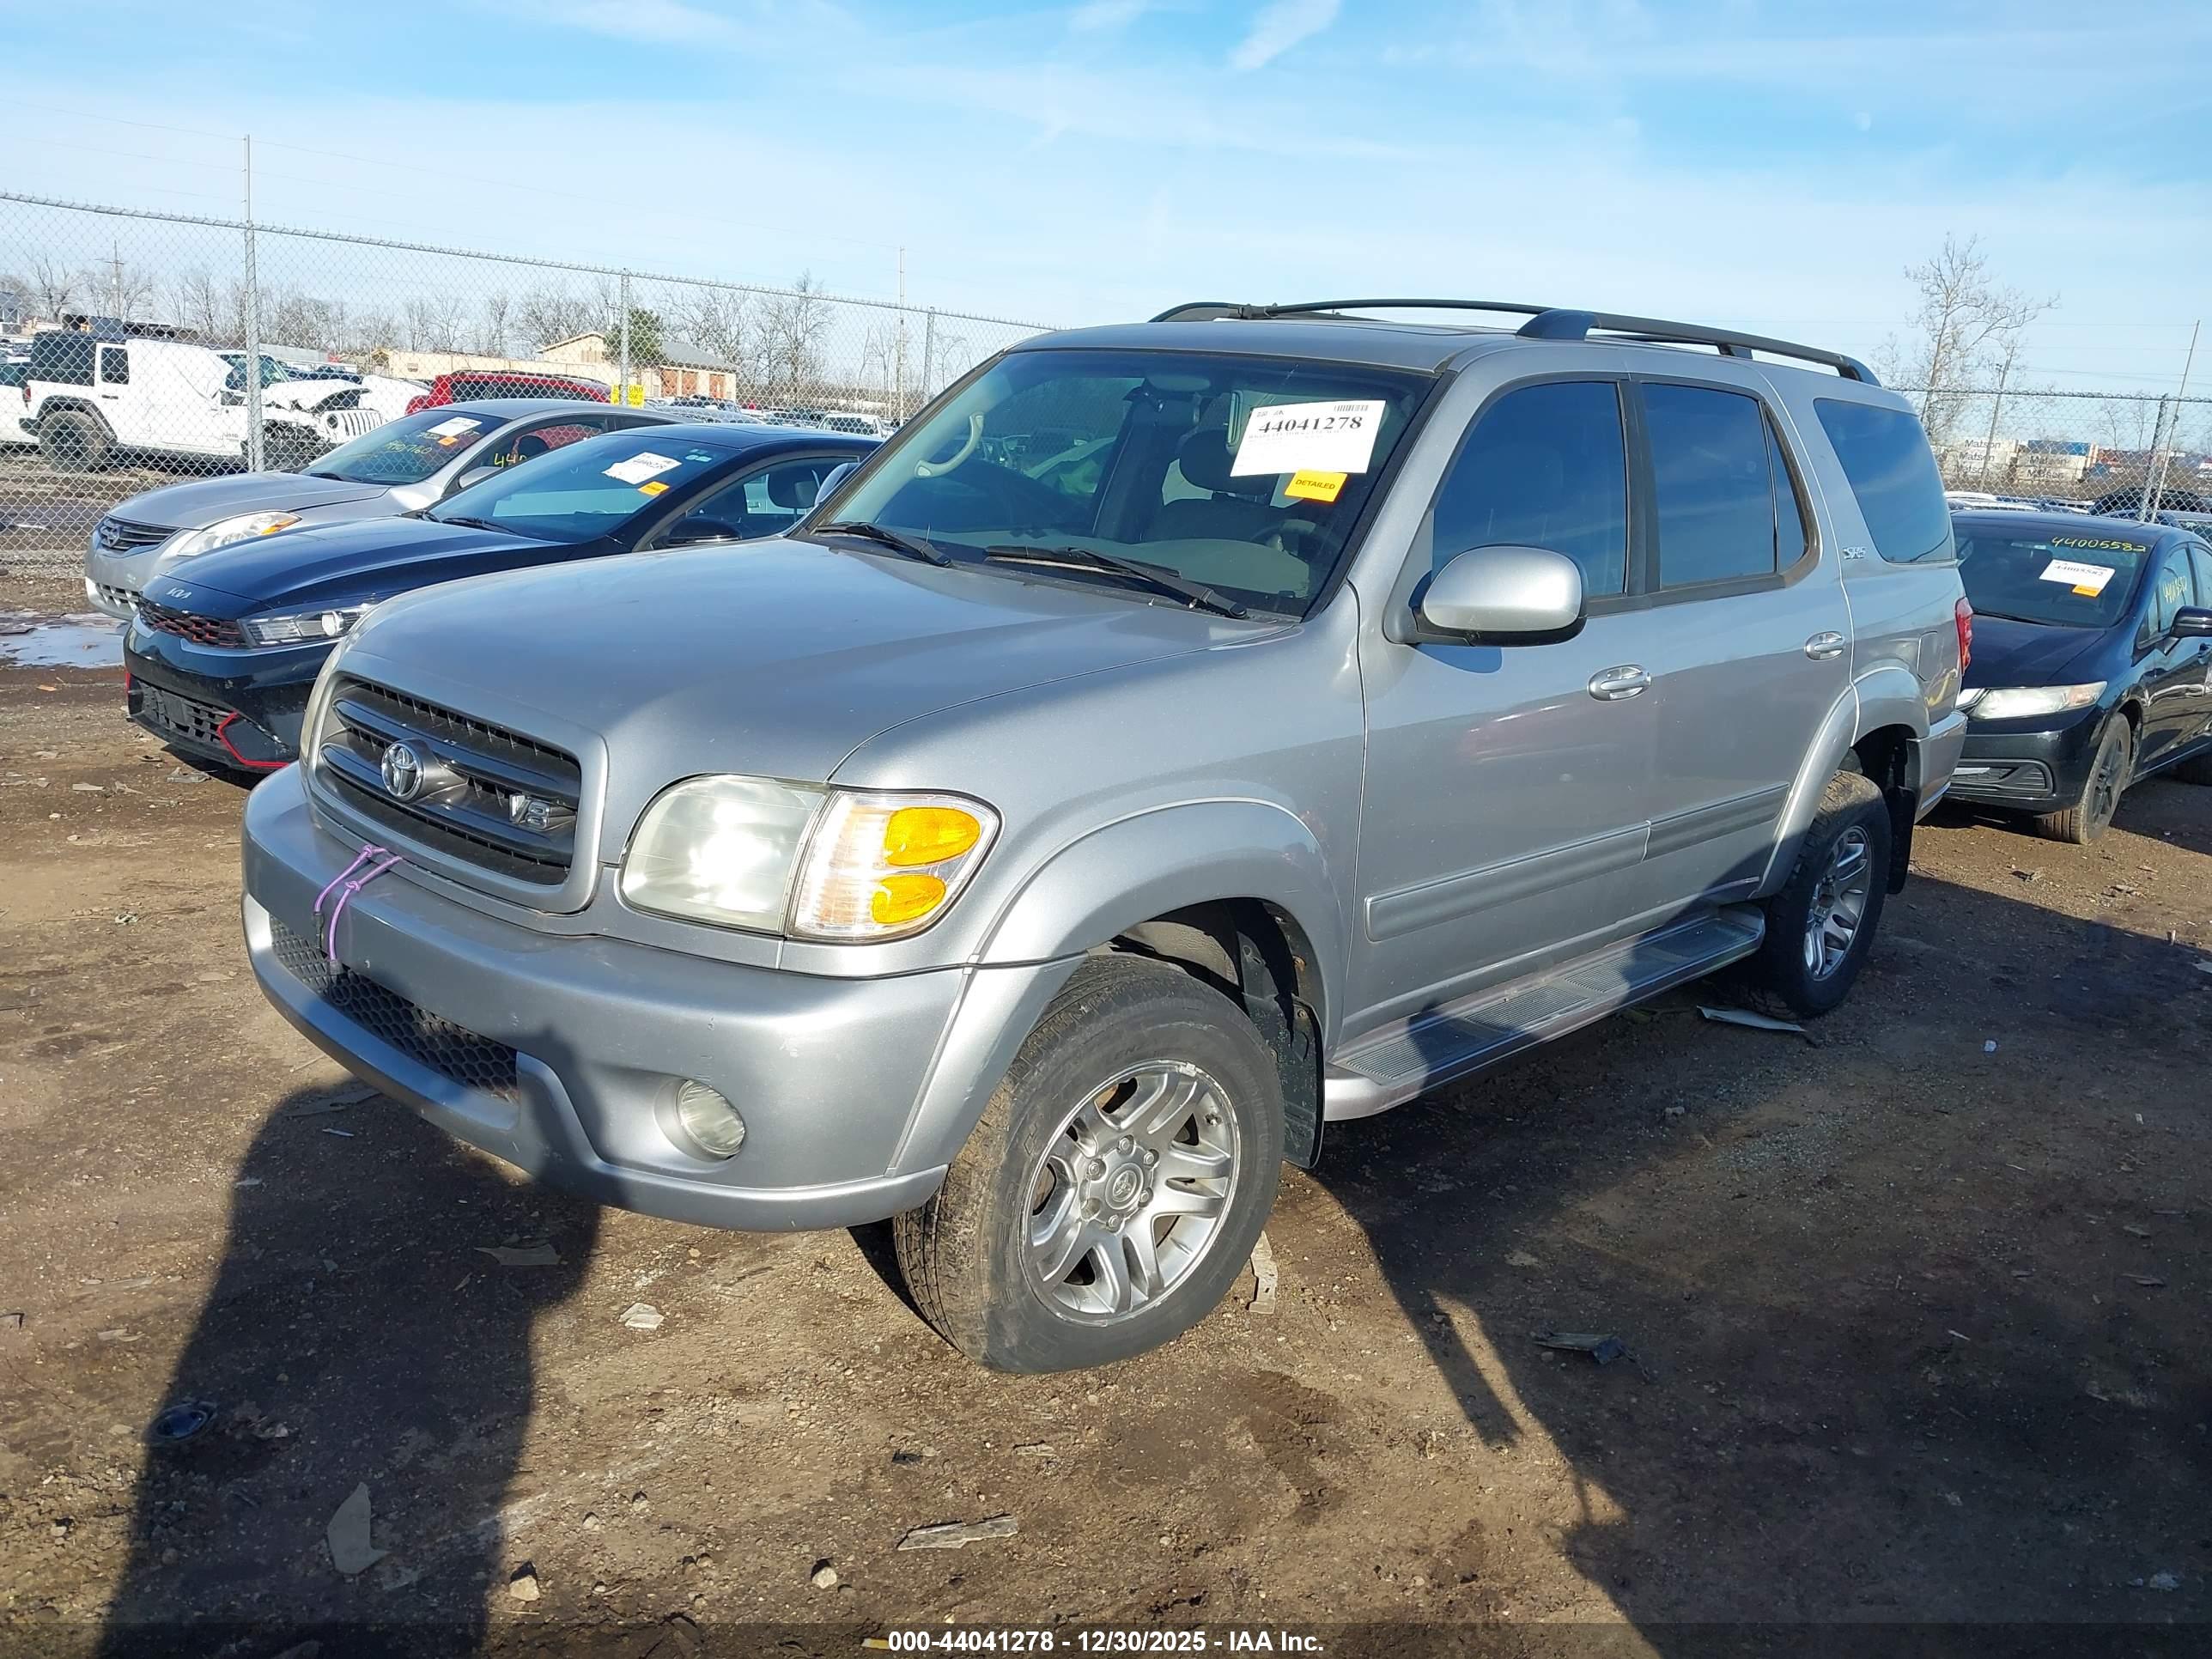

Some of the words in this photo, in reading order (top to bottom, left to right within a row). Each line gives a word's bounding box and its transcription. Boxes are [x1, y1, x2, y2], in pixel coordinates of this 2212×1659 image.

[1258, 416, 1364, 434] 44041278
[1295, 479, 1336, 489] DETAILED
[2051, 536, 2147, 552] 44005582
